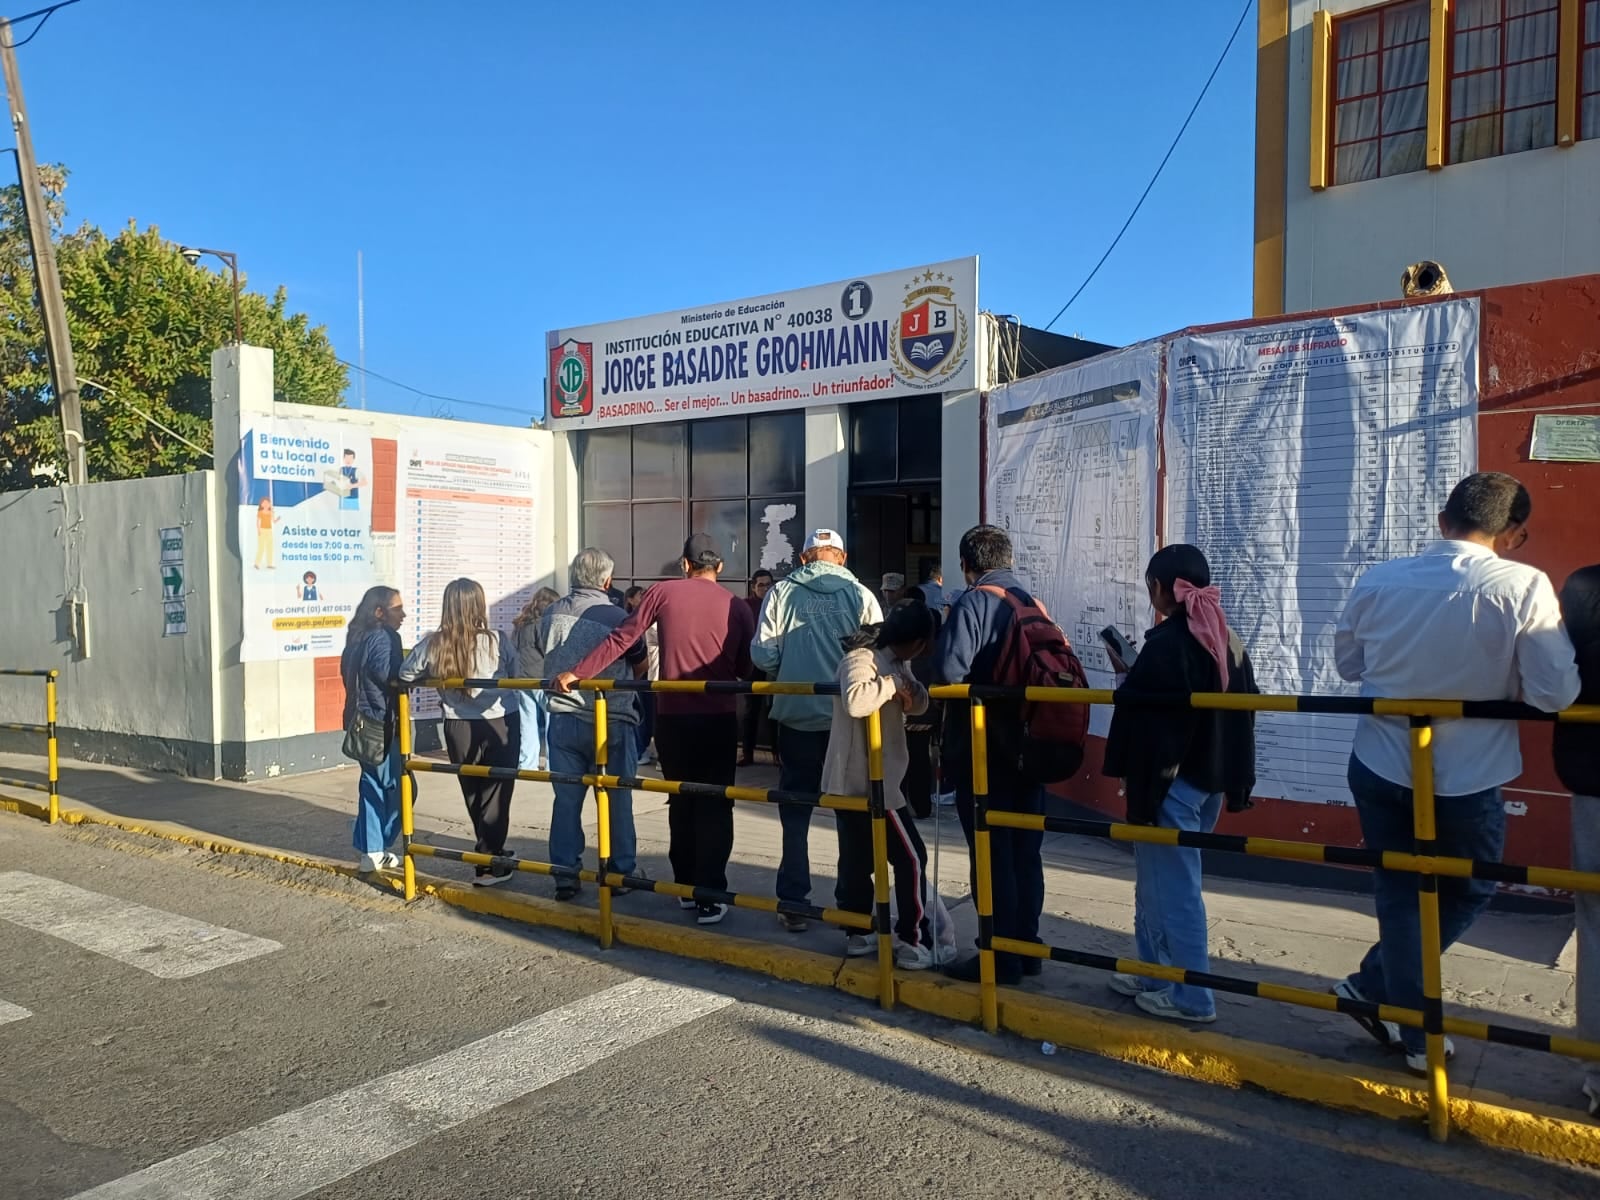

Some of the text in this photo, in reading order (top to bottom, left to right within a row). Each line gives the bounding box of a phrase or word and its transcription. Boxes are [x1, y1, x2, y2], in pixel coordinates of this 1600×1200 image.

[849, 290, 864, 316] 1
[680, 300, 785, 324] Ministerio de Educación
[909, 310, 947, 332] J B
[605, 307, 833, 355] INSTITUCIÓN EDUCATIVA N° 40038
[1258, 338, 1347, 356] MESAS DE SUFRAGIO
[601, 354, 656, 396] JORGE
[662, 341, 749, 387] BASADRE
[756, 319, 888, 377] GROHMANN
[596, 400, 663, 423] ¡BASADRINO...
[664, 398, 680, 412] Ser
[681, 396, 690, 410] el
[692, 394, 729, 412] mejor...
[731, 391, 745, 405] Un
[748, 386, 810, 403] basadrino...
[813, 382, 828, 396] Un
[831, 372, 895, 394] triunfador!
[260, 433, 330, 450] Bienvenido
[260, 450, 335, 465] a tu local de
[261, 464, 316, 477] votación
[282, 525, 361, 538] Asiste a votar
[282, 540, 308, 549] desde
[310, 541, 323, 549] las
[324, 541, 342, 550] 7:00
[282, 553, 308, 561] hasta
[310, 553, 321, 561] las
[265, 607, 284, 615] Fono
[285, 606, 306, 614] ONPE
[307, 605, 320, 614] (01)
[284, 644, 309, 652] ONPE
